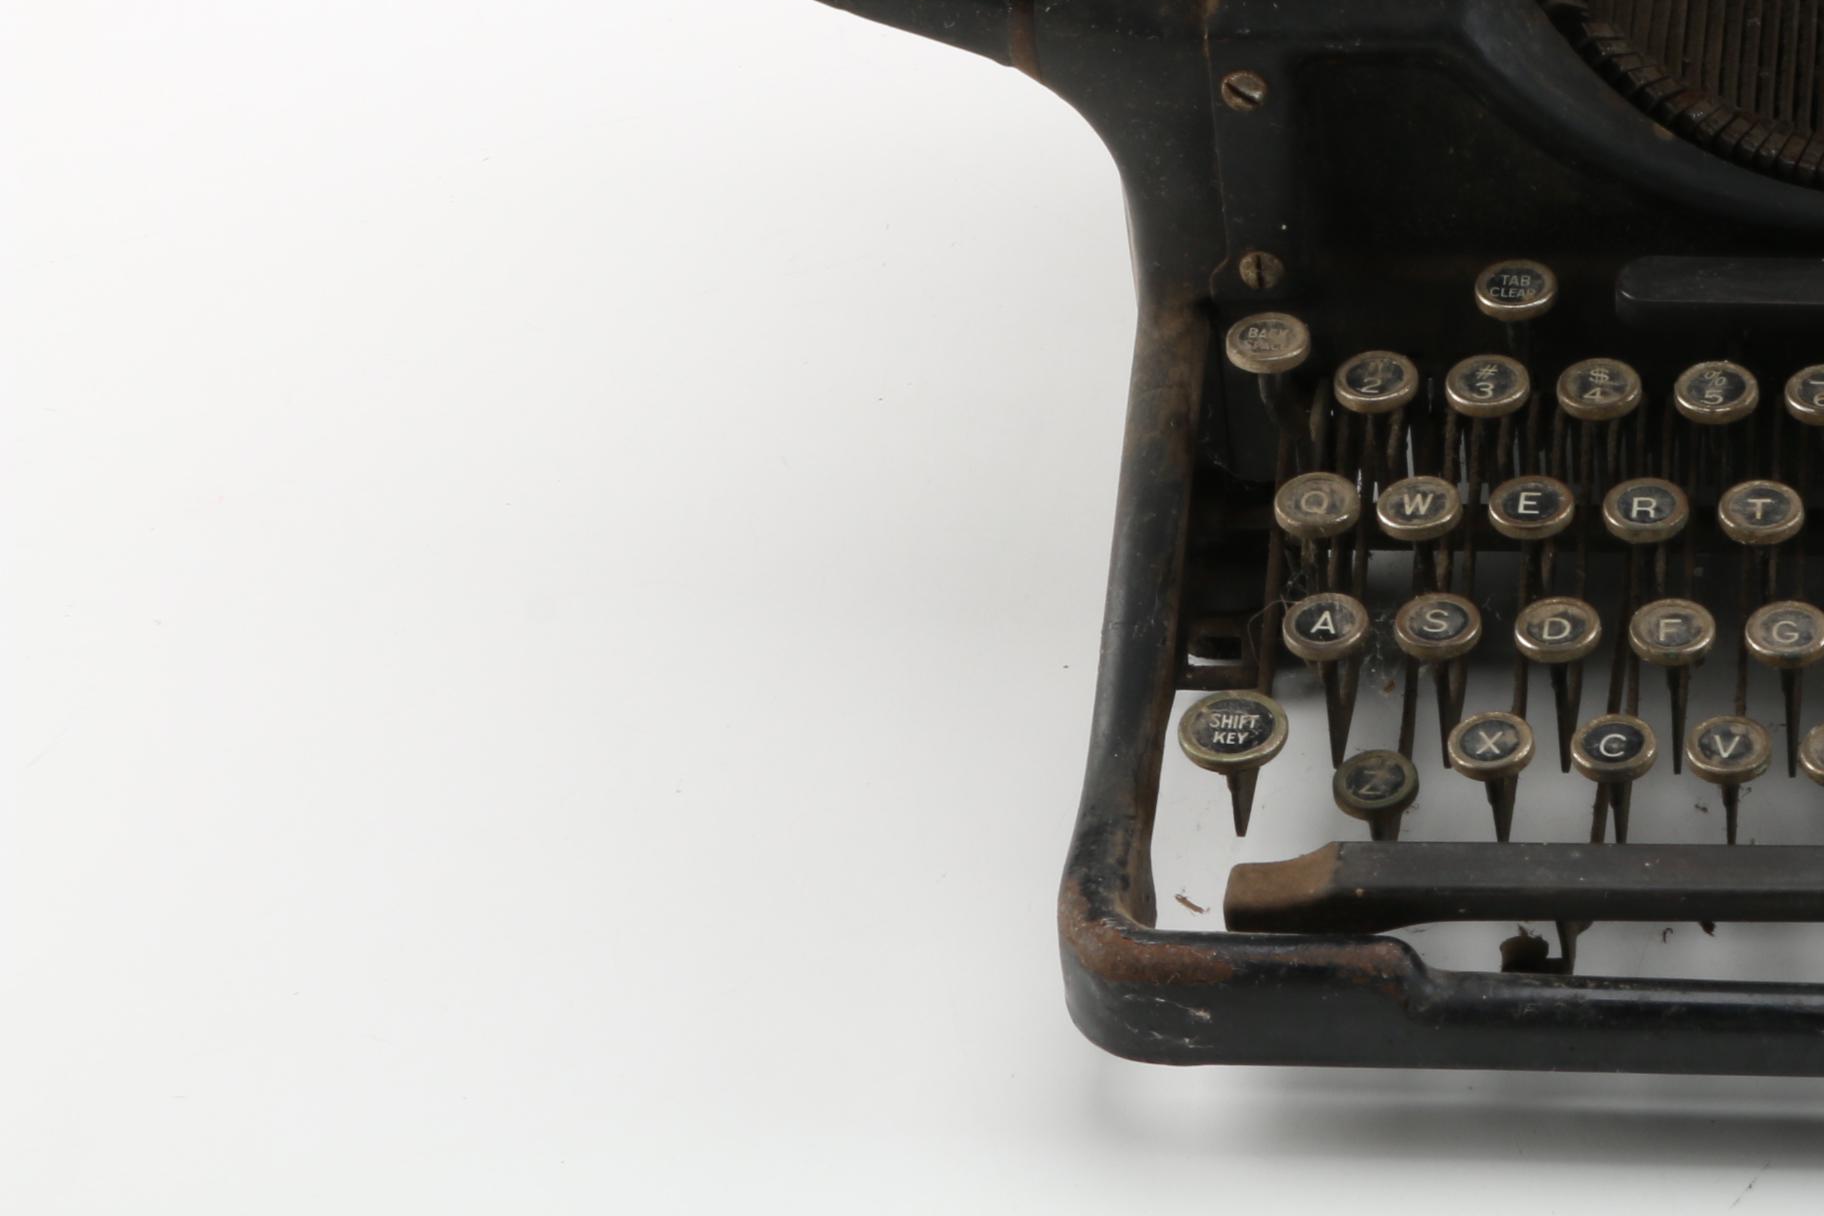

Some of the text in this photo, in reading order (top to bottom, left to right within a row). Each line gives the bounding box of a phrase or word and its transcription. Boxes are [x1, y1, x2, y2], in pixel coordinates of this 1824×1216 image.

[1489, 286, 1537, 299] CLEAR
[1501, 274, 1532, 287] TAB
[1358, 376, 1383, 393] 2
[1475, 381, 1496, 399] 3
[1582, 387, 1605, 402] 4
[1702, 389, 1725, 405] 5
[1300, 490, 1329, 515] Q
[1402, 492, 1434, 516] W
[1516, 490, 1541, 516] E
[1631, 496, 1657, 519] R
[1746, 497, 1775, 520] T
[1309, 609, 1337, 635] A
[1424, 608, 1448, 634] S
[1541, 616, 1572, 641] D
[1658, 618, 1683, 642] F
[1770, 619, 1801, 645] G
[1209, 712, 1261, 730] SHIFT
[1212, 731, 1250, 745] KEY
[1475, 729, 1504, 755] X
[1599, 732, 1627, 758] C
[1712, 733, 1741, 759] V
